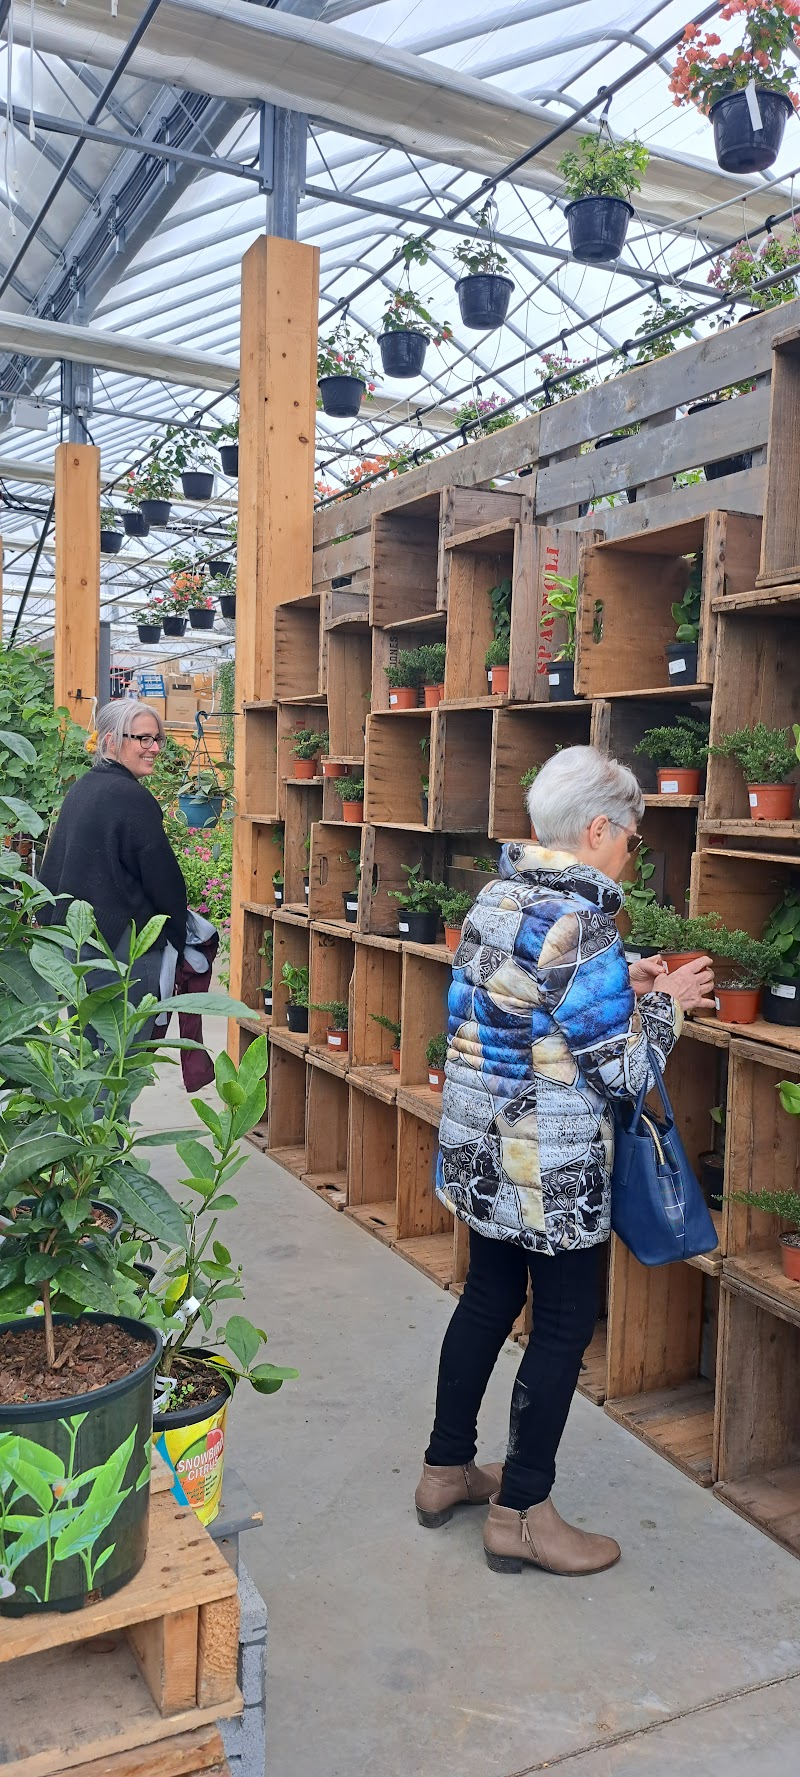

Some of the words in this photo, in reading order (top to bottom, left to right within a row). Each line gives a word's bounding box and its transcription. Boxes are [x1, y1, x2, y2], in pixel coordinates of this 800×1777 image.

[389, 636, 398, 668] JONES
[177, 1437, 224, 1473] SNOWBIRD
[188, 1455, 219, 1481] CITRUS
